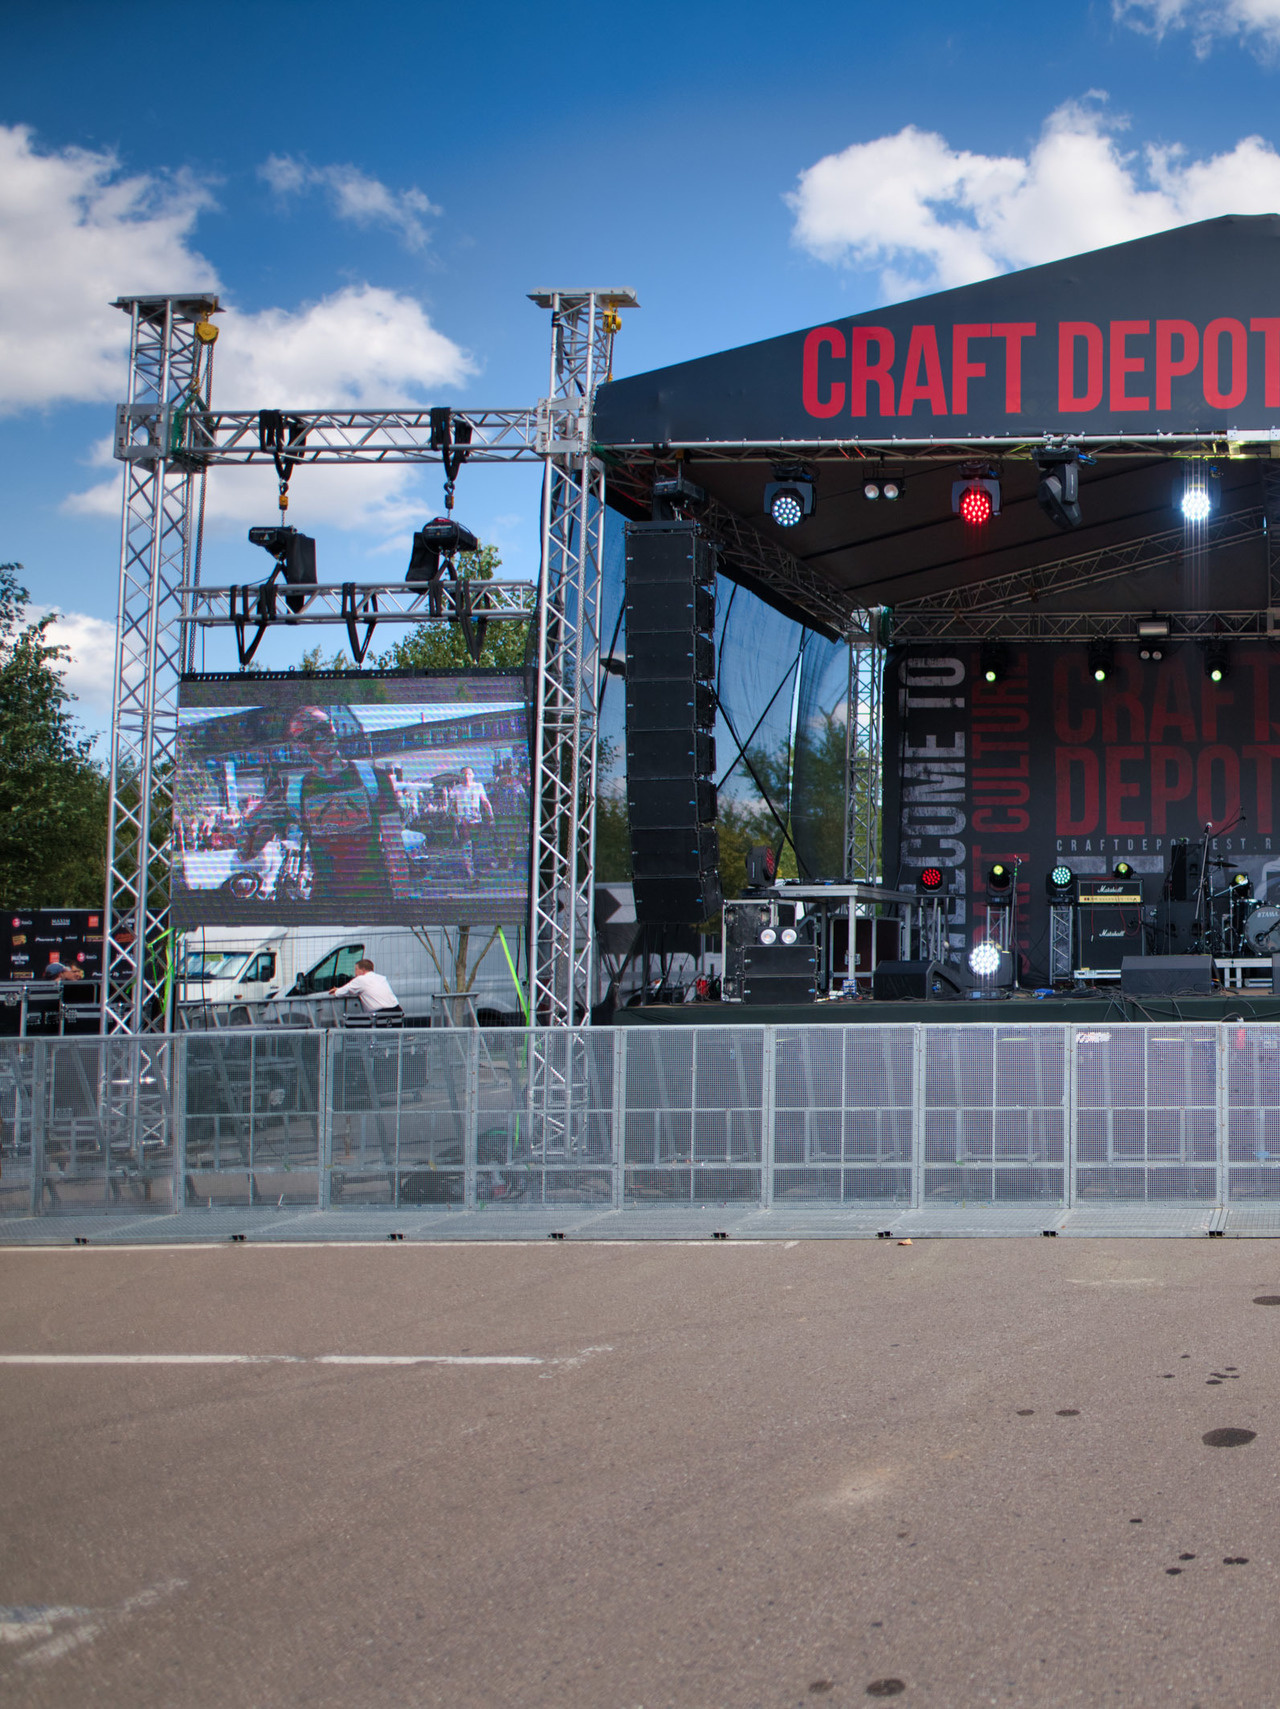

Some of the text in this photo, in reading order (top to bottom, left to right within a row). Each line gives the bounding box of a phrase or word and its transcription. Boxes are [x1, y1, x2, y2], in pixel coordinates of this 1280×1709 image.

[803, 322, 1036, 419] CRAFT
[898, 656, 966, 718] TO
[972, 652, 1030, 976] RAFT CULTURE
